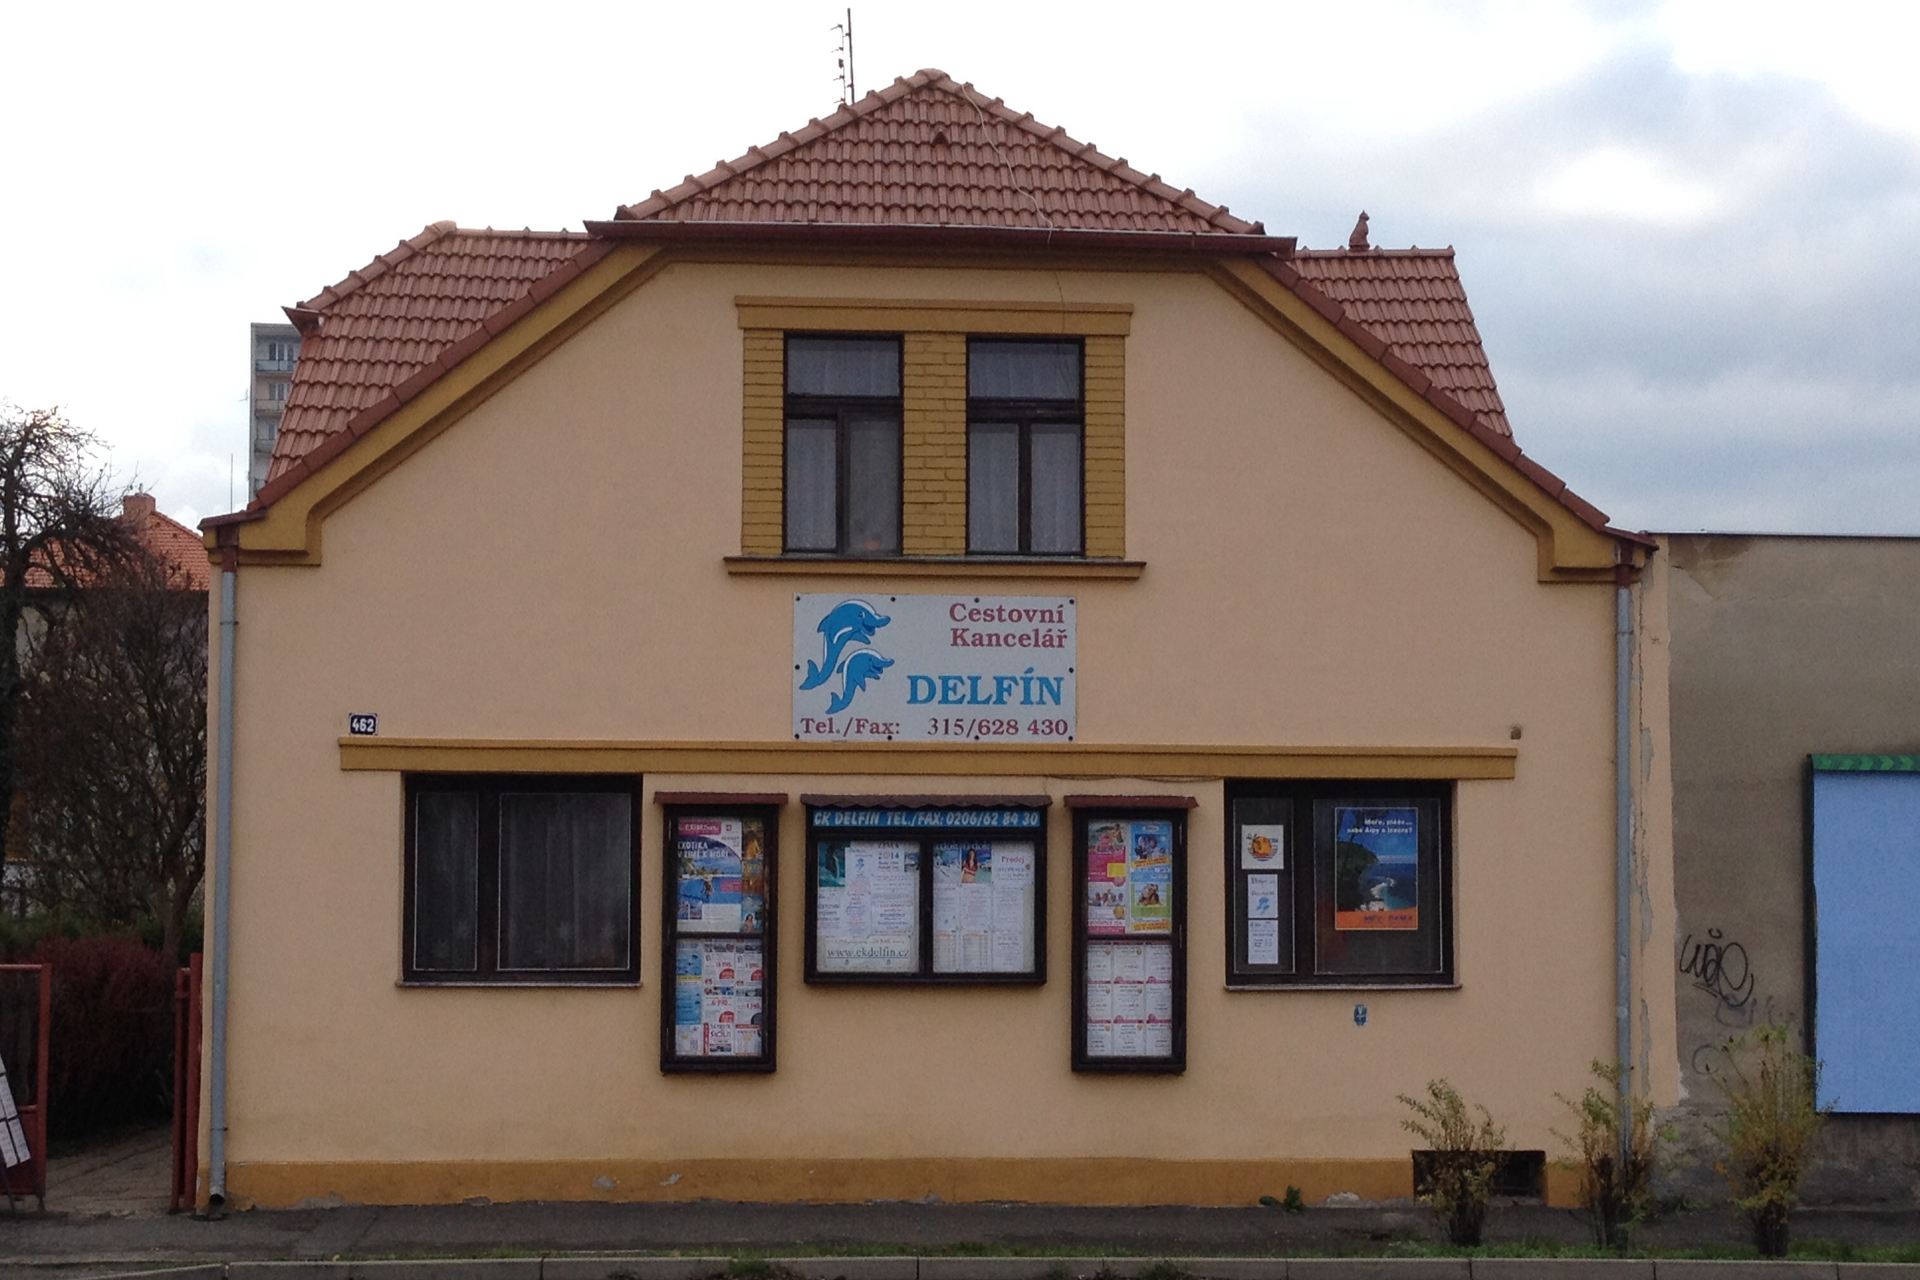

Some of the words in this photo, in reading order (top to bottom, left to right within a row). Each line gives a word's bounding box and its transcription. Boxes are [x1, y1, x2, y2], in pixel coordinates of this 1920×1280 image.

[949, 603, 1065, 623] Cestovní
[950, 628, 1067, 648] Kancelář
[907, 667, 1065, 706] DELFÍN
[352, 718, 374, 732] 462
[800, 717, 900, 737] Tel./Fax:
[927, 718, 1019, 738] 315/628
[1027, 719, 1068, 736] 430
[814, 811, 831, 826] CK
[946, 811, 998, 826] 0206/62
[1002, 811, 1018, 825] 84
[1022, 811, 1038, 825] 30
